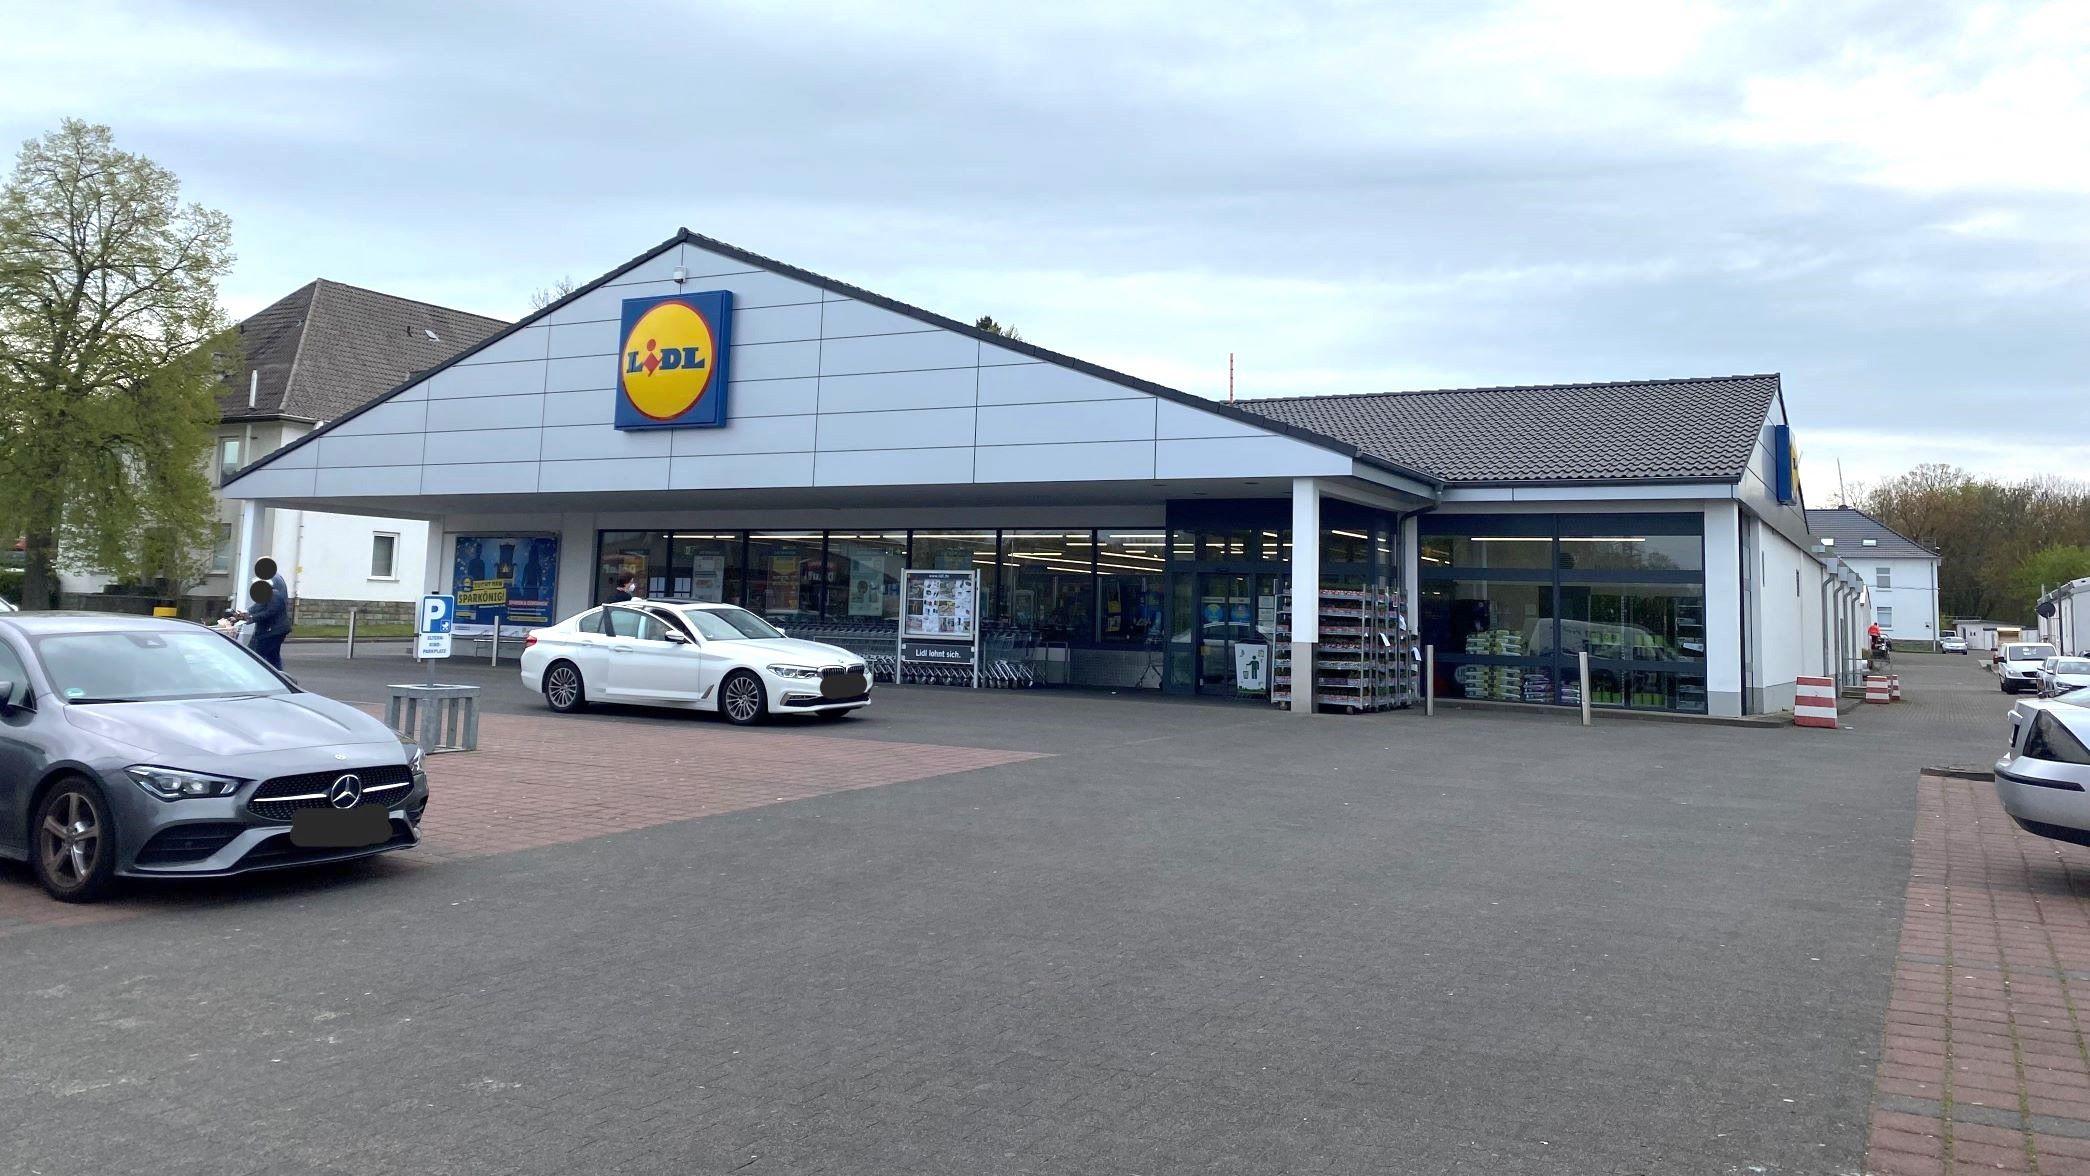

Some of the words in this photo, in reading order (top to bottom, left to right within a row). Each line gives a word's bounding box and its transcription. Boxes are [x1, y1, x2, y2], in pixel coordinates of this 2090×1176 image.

[458, 591, 505, 603] SPARKÖNIG!
[422, 598, 446, 632] P
[915, 649, 927, 657] Lidl
